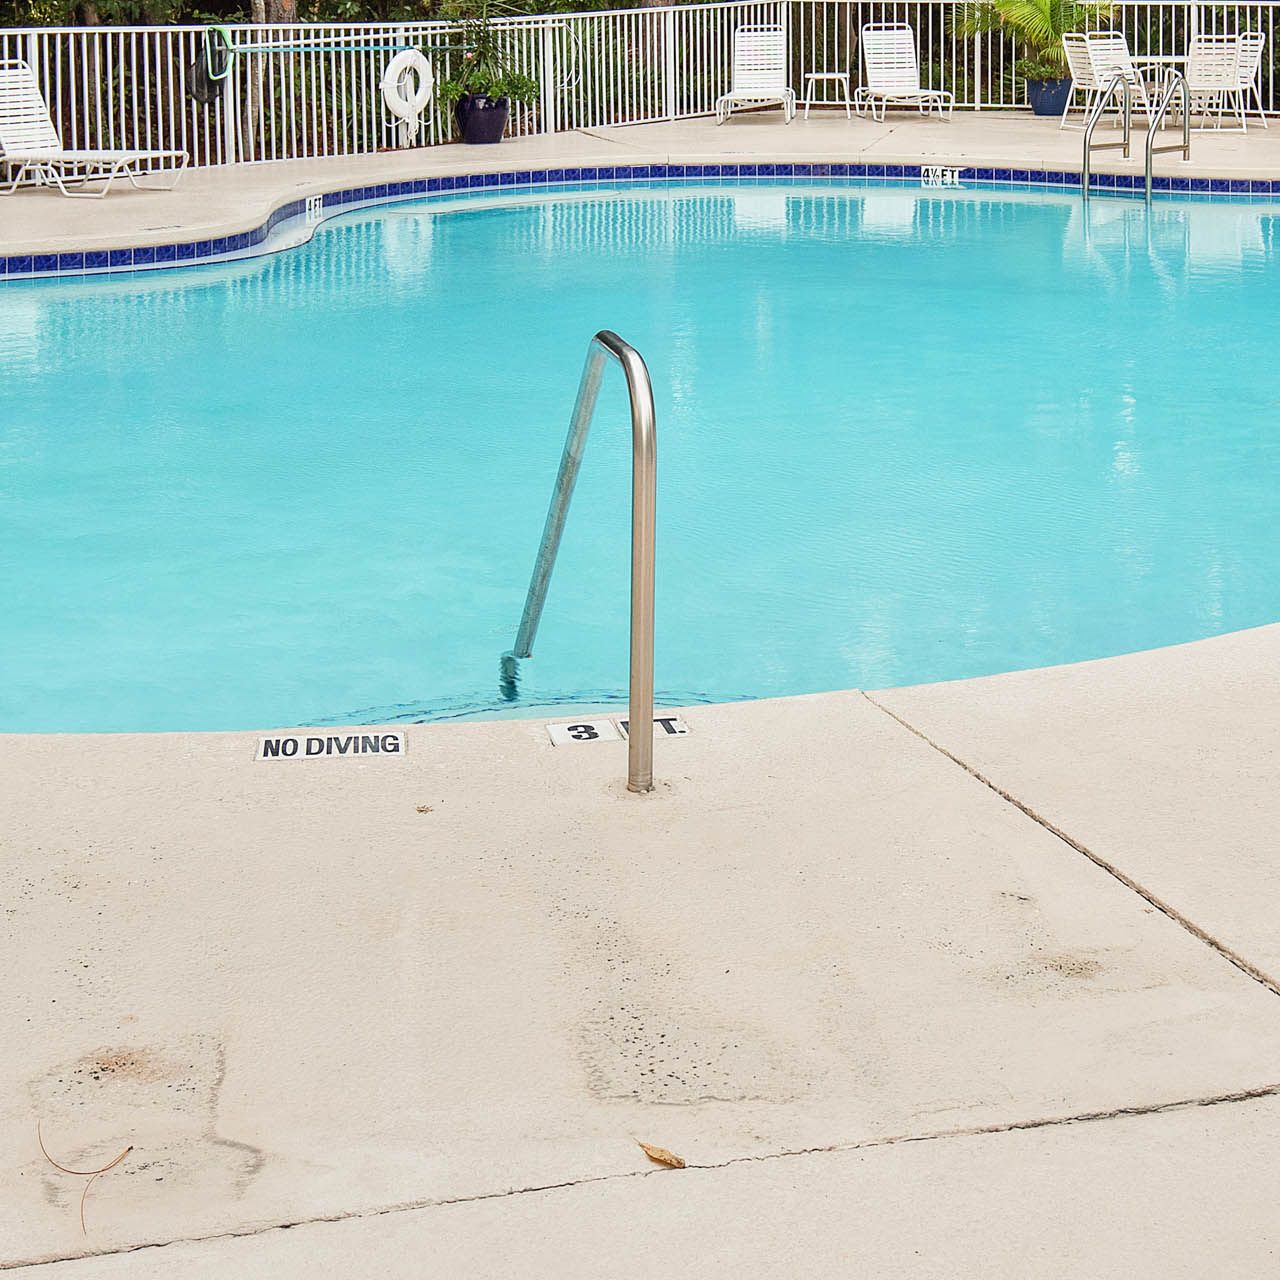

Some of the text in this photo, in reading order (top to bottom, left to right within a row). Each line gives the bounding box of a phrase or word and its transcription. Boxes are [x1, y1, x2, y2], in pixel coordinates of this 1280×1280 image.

[567, 723, 600, 741] 3
[263, 734, 401, 758] NO DIVING
